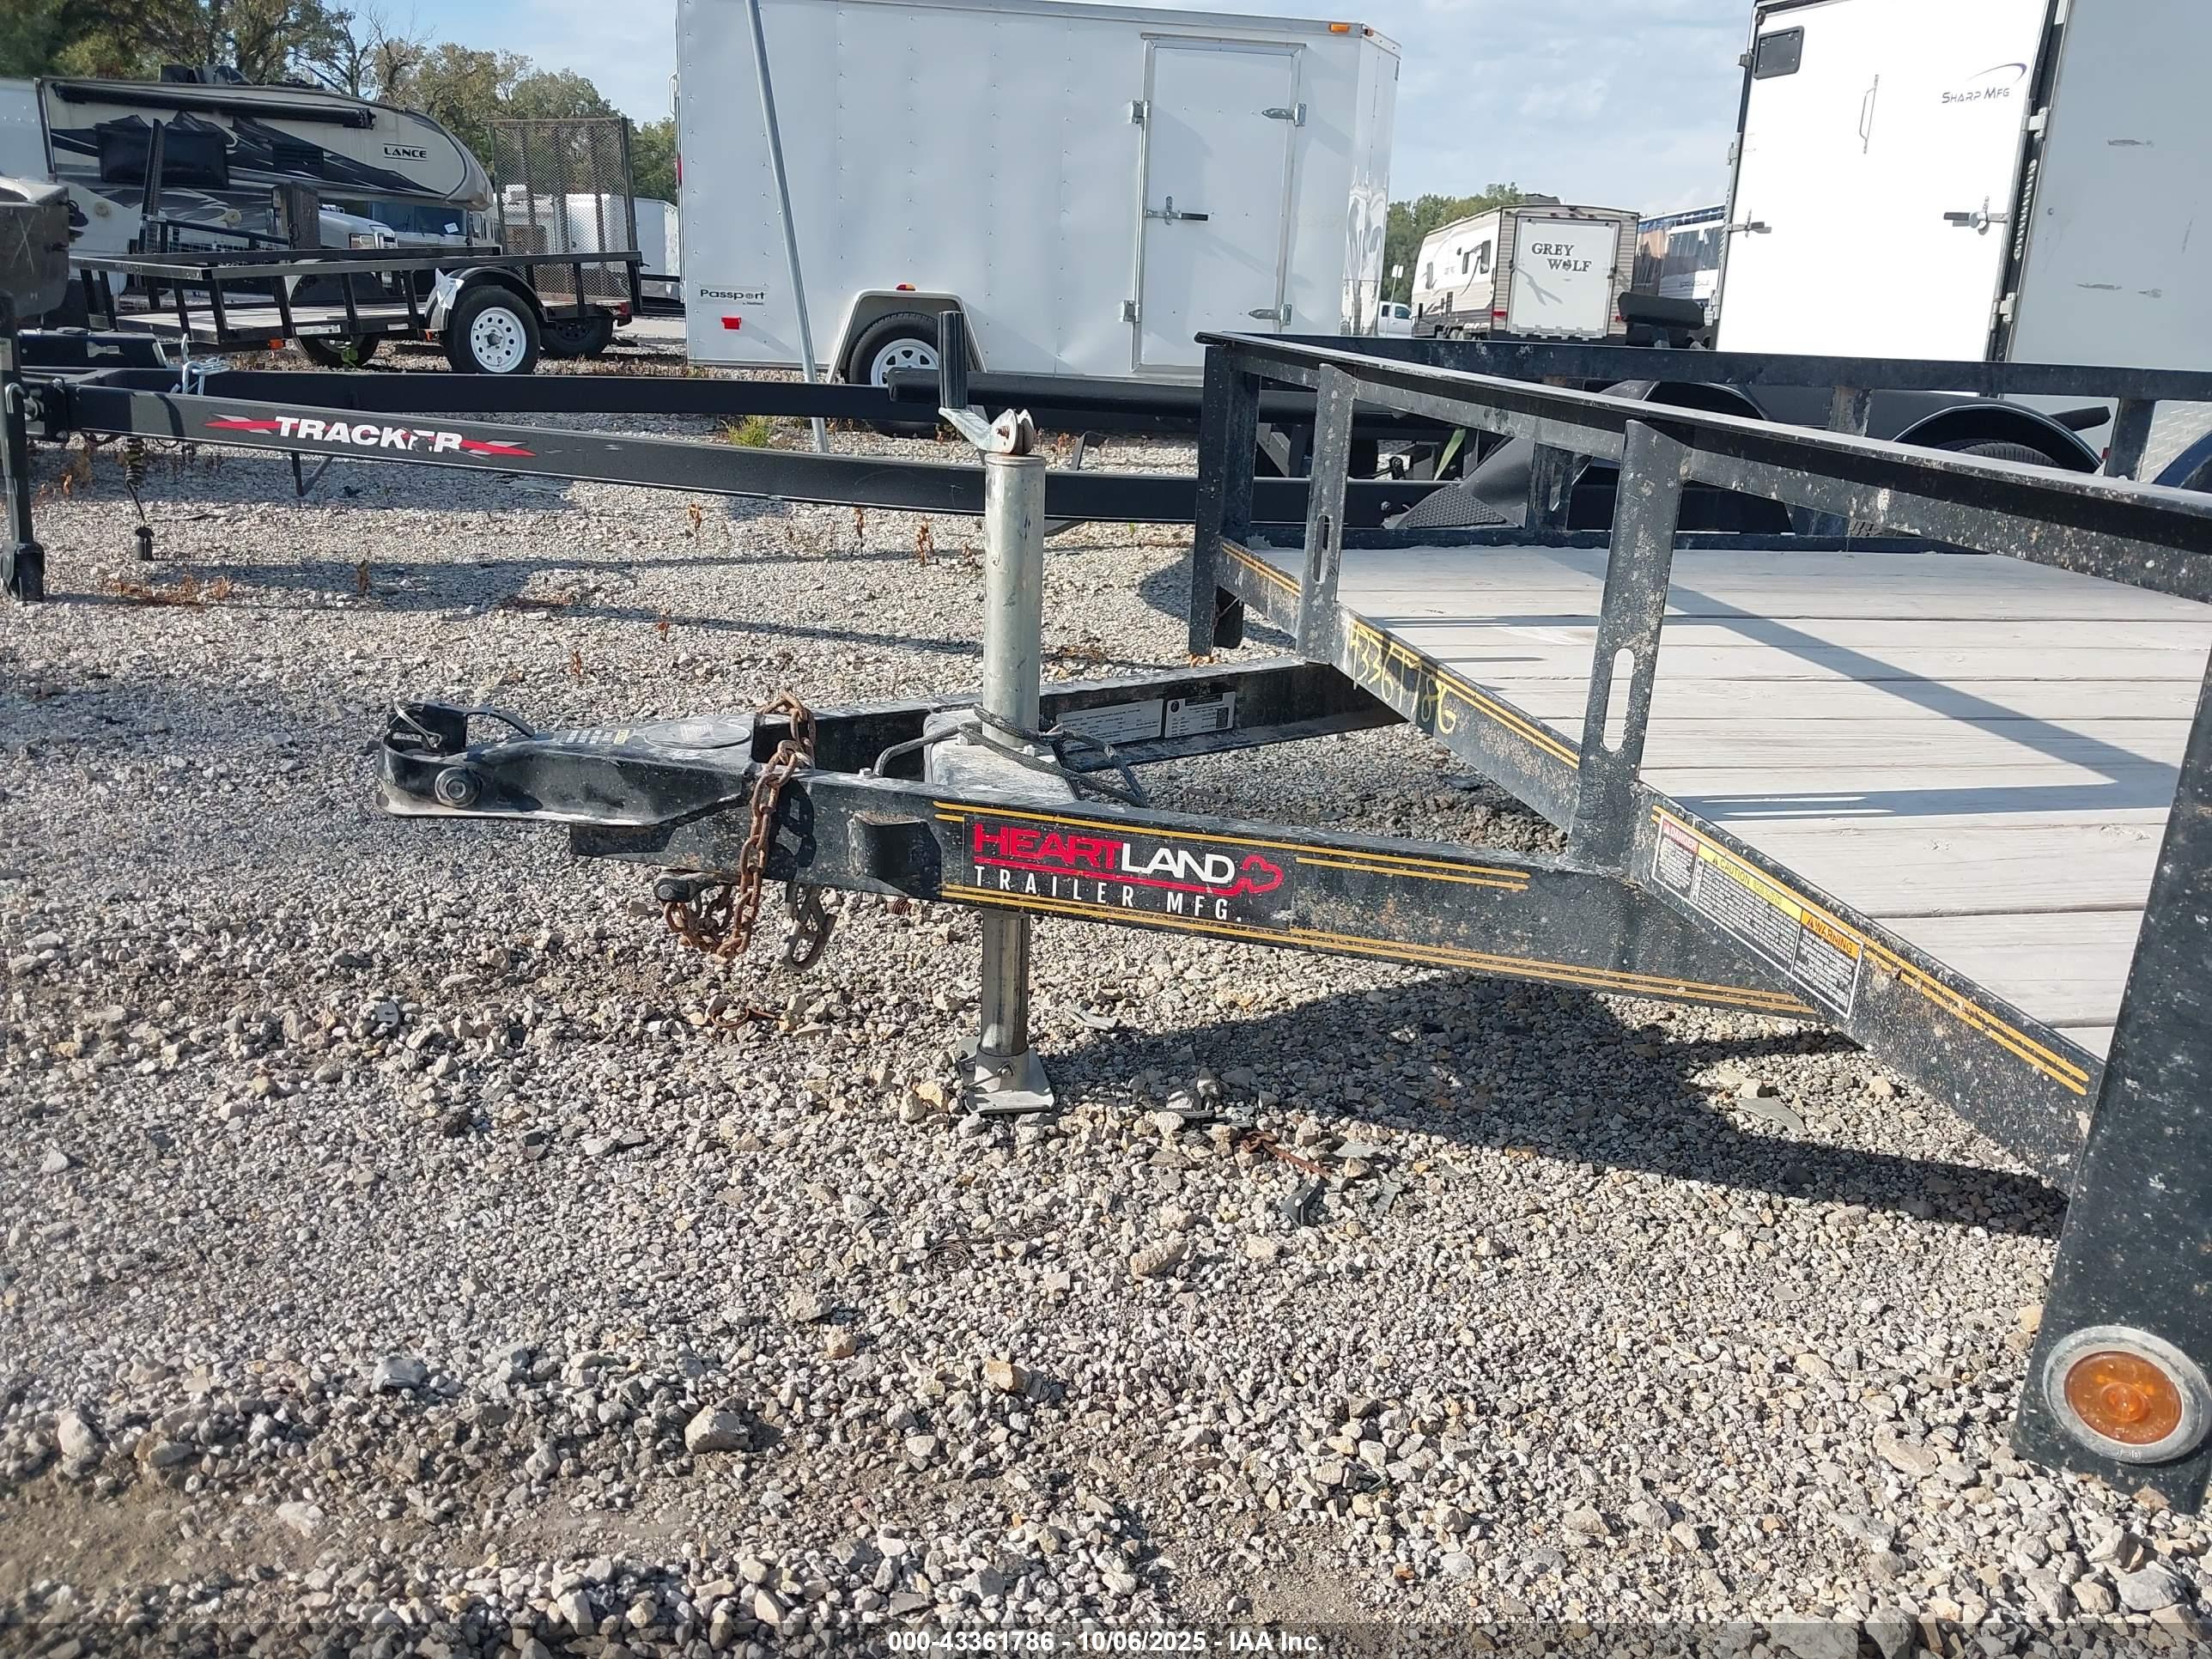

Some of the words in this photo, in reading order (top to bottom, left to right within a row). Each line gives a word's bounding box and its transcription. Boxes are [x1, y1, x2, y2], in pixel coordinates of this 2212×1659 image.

[384, 147, 427, 159] LANCE
[1531, 242, 1575, 256] GREY
[1547, 258, 1592, 272] WOLF
[700, 289, 765, 301] Passport
[275, 416, 463, 453] TRACKER
[974, 823, 1236, 884] HEARTLAND
[1720, 859, 1751, 885] CAUTION
[974, 865, 1134, 908] TRAILER
[1166, 892, 1243, 921] MFG.
[1814, 919, 1854, 954] WARNING
